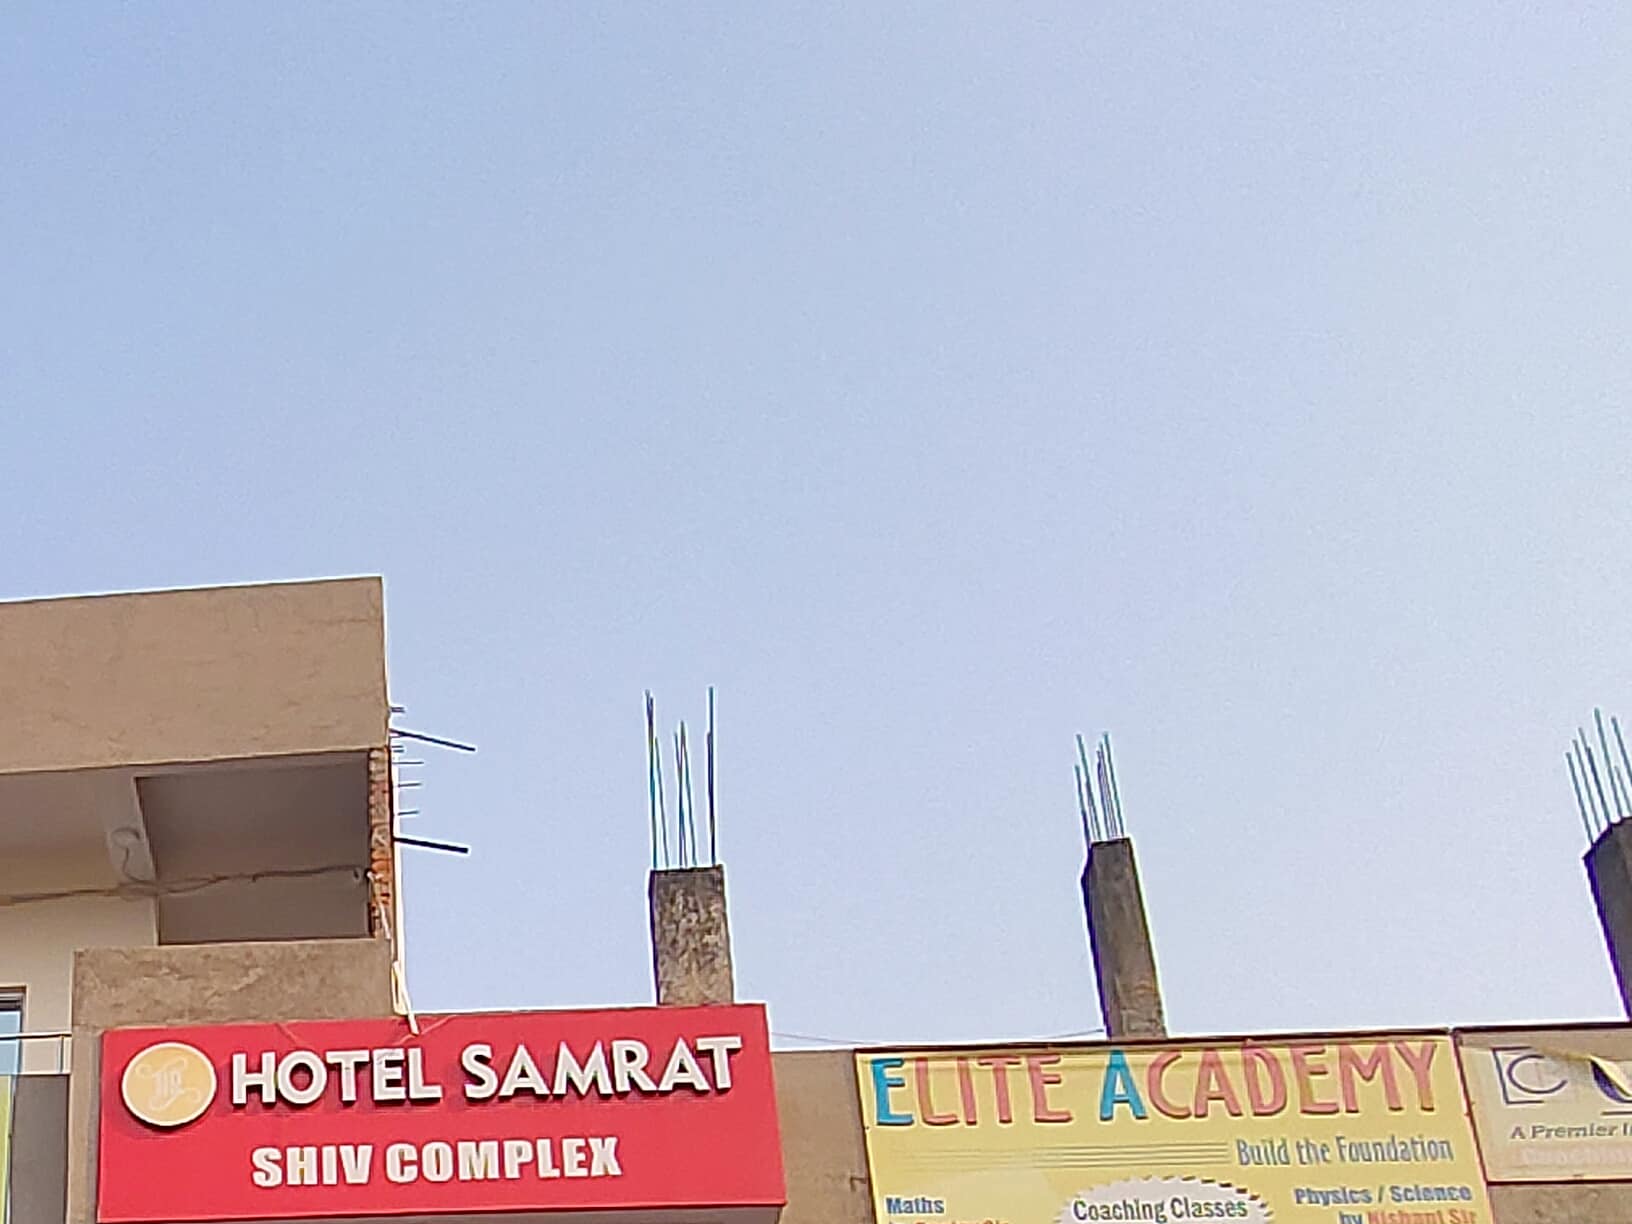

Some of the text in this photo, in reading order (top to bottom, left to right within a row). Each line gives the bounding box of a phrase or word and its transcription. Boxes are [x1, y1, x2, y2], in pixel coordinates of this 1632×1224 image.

[231, 1036, 742, 1106] HOTEL SAMRAT
[870, 1040, 1437, 1126] ELITE ACADEMY
[1511, 1122, 1619, 1140] A Premier
[251, 1137, 622, 1187] SHIV COMPLEX
[1236, 1136, 1454, 1166] Build the Foundation
[886, 1197, 945, 1214] Maths
[1295, 1184, 1473, 1206] Physics Science
[1073, 1197, 1248, 1224] Coaching Classes
[1449, 1208, 1477, 1224] Sir
